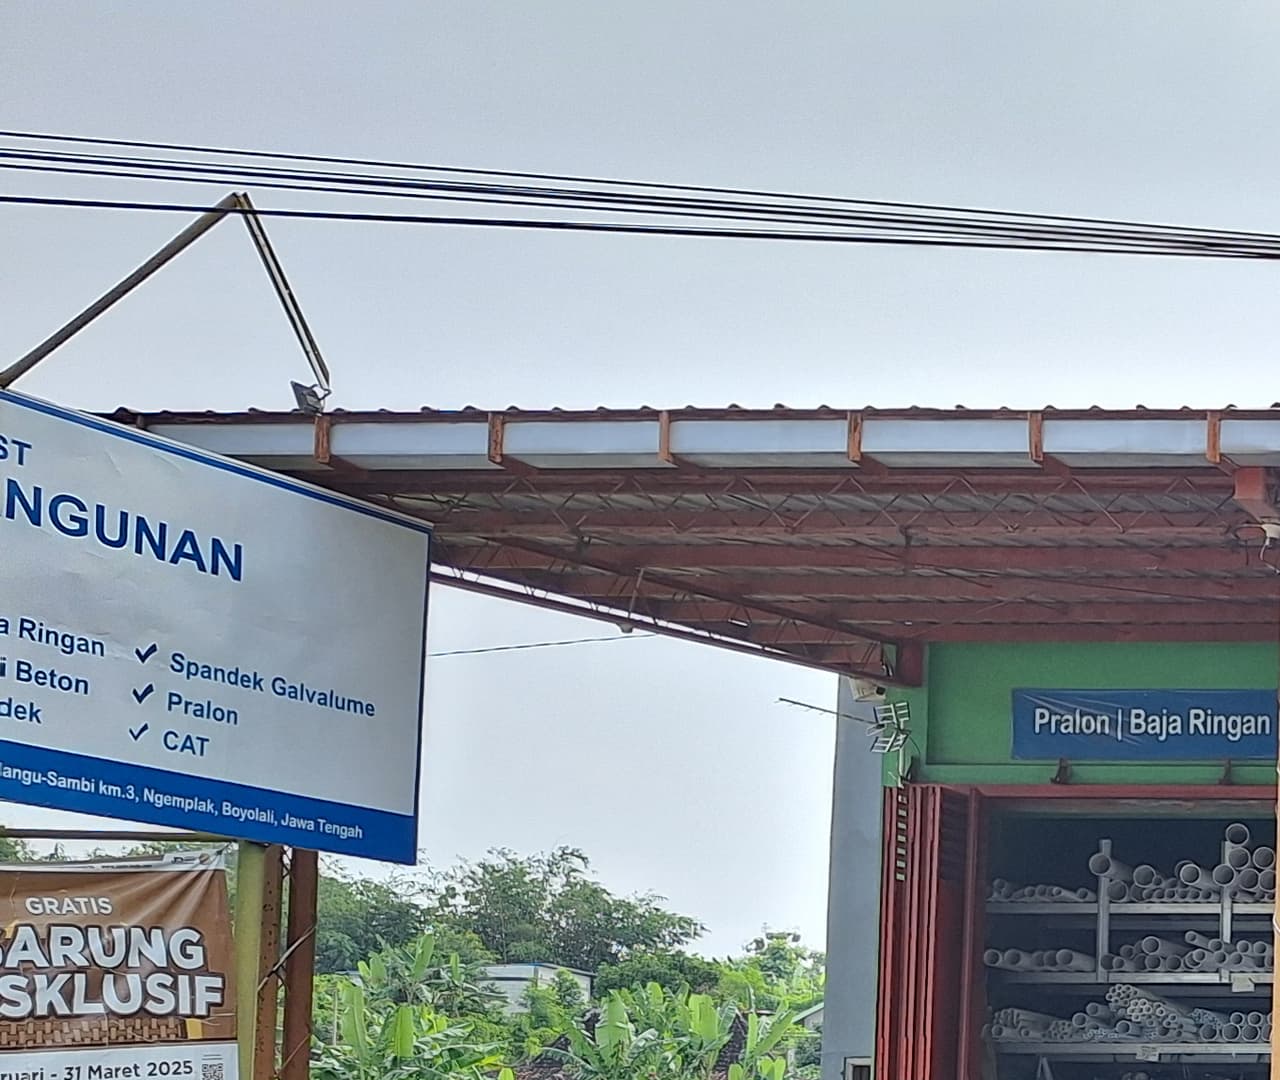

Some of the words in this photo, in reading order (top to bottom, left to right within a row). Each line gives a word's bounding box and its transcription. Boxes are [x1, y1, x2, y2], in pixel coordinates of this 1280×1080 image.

[0, 478, 243, 582] NGUNAN
[18, 617, 105, 657] Ringan
[16, 660, 89, 695] Beton
[169, 652, 265, 692] Spandek
[271, 676, 376, 717] Galvalume
[167, 691, 239, 725] Pralon
[1033, 707, 1110, 735] Pralon
[1129, 708, 1183, 742] Baja
[1188, 708, 1271, 742] Ringan
[163, 730, 210, 757] CAT
[0, 762, 95, 793] angu-Sambi
[99, 780, 140, 804] km.3,
[143, 788, 219, 816] Ngemplak,
[222, 801, 278, 826] Boyolali,
[281, 813, 315, 832] Jawa
[317, 818, 363, 839] Tengah
[25, 897, 113, 916] GRATIS
[0, 926, 206, 971] ARUNG
[0, 972, 224, 1018] SKLUSIF
[88, 1063, 141, 1080] Maret
[147, 1060, 194, 1077] 2025
